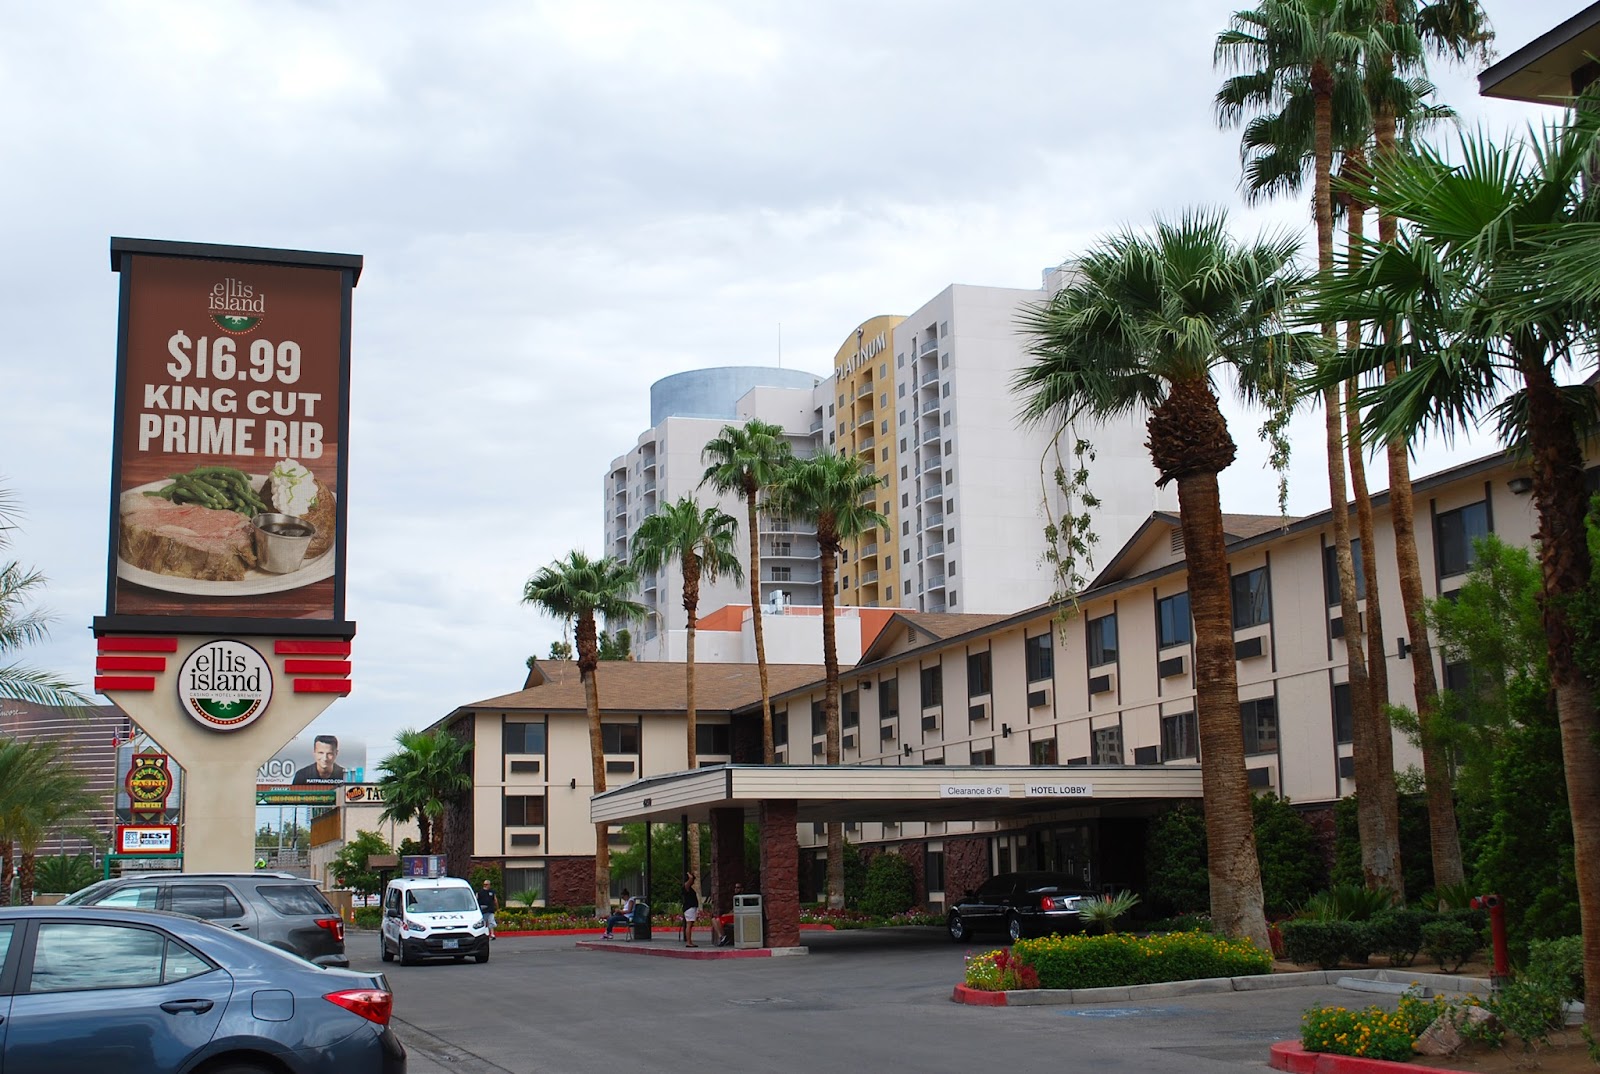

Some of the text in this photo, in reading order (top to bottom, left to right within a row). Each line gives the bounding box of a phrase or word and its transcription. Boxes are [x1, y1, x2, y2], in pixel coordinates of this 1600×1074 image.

[213, 278, 253, 298] ellis
[208, 293, 265, 312] island
[166, 329, 301, 384] $16.99
[836, 329, 886, 384] PLATINUM
[143, 384, 322, 417] KING CUT
[138, 413, 324, 459] PRIME RIB
[196, 647, 246, 673] ellis
[190, 667, 262, 692] island
[947, 786, 985, 795] Clearance
[1031, 786, 1087, 794] HOTEL LOBBY
[140, 832, 170, 840] BEST
